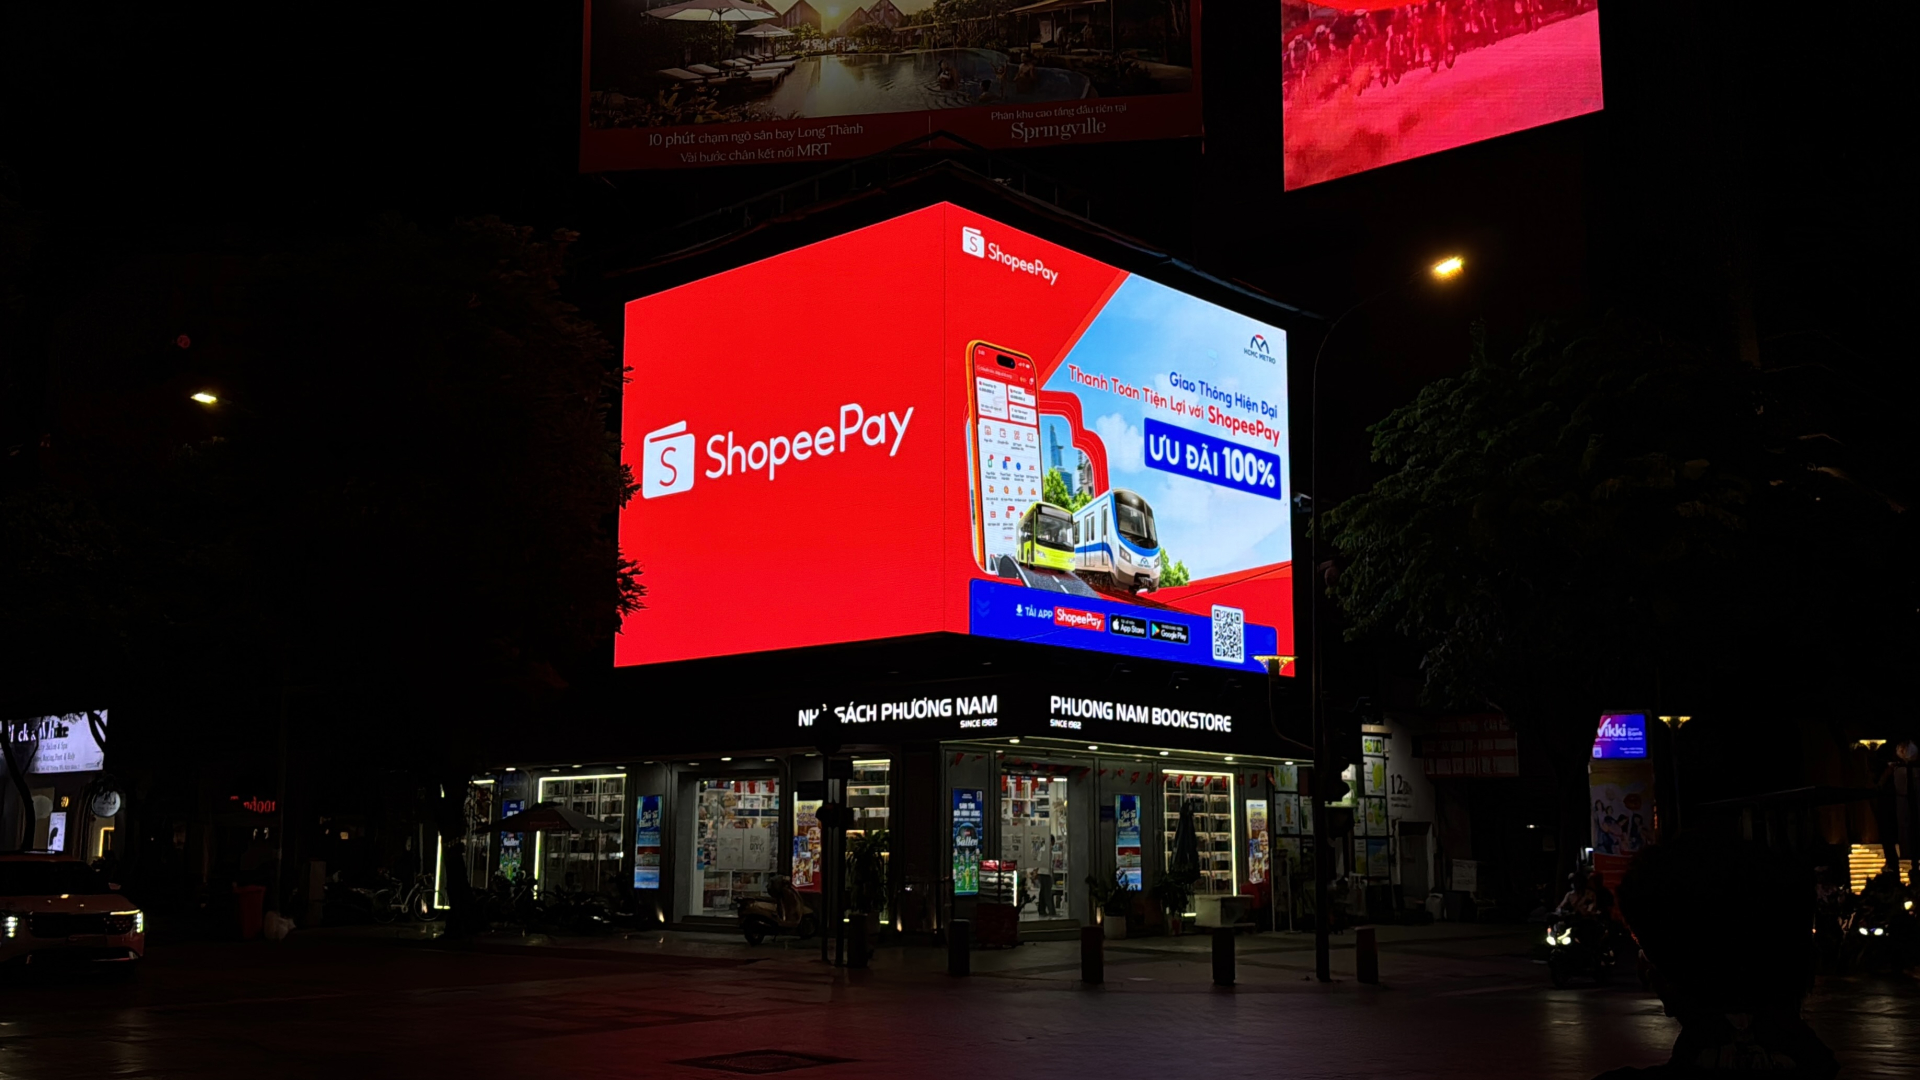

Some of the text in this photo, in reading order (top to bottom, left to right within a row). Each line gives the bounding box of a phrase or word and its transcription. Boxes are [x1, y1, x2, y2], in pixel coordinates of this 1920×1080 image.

[1016, 109, 1034, 119] khu
[1035, 109, 1052, 118] cao
[649, 133, 662, 146] 10
[665, 131, 695, 148] phút
[698, 132, 728, 145] chạm
[753, 129, 773, 140] sân
[775, 126, 795, 141] bay
[797, 126, 826, 139] Long
[827, 122, 864, 136] Thành
[1010, 117, 1107, 143] Springville
[729, 149, 755, 161] chân
[797, 142, 832, 157] MRT
[987, 242, 1059, 286] ShopeePay
[1243, 347, 1277, 365] HCMC METRO
[1068, 364, 1280, 448] Thanh Toán Tiện Lợi với ShopeePay
[1169, 371, 1278, 420] Giao Thông Hiện Đại
[705, 403, 915, 481] ShopeePay
[1149, 433, 1276, 489] ƯU ĐÃI 100%
[1038, 608, 1054, 619] APP
[1056, 608, 1102, 630] ShopeePay
[1120, 623, 1145, 635] App Store
[1160, 629, 1187, 642] Google Play
[833, 701, 877, 724] SÁCH
[881, 697, 952, 721] PHƯƠNG
[956, 695, 998, 716] NAM
[1050, 695, 1232, 733] PHUONG NAM BOOKSTORE
[960, 719, 981, 729] SINCE
[1050, 718, 1068, 728] SINCE
[1597, 717, 1627, 738] Vikki
